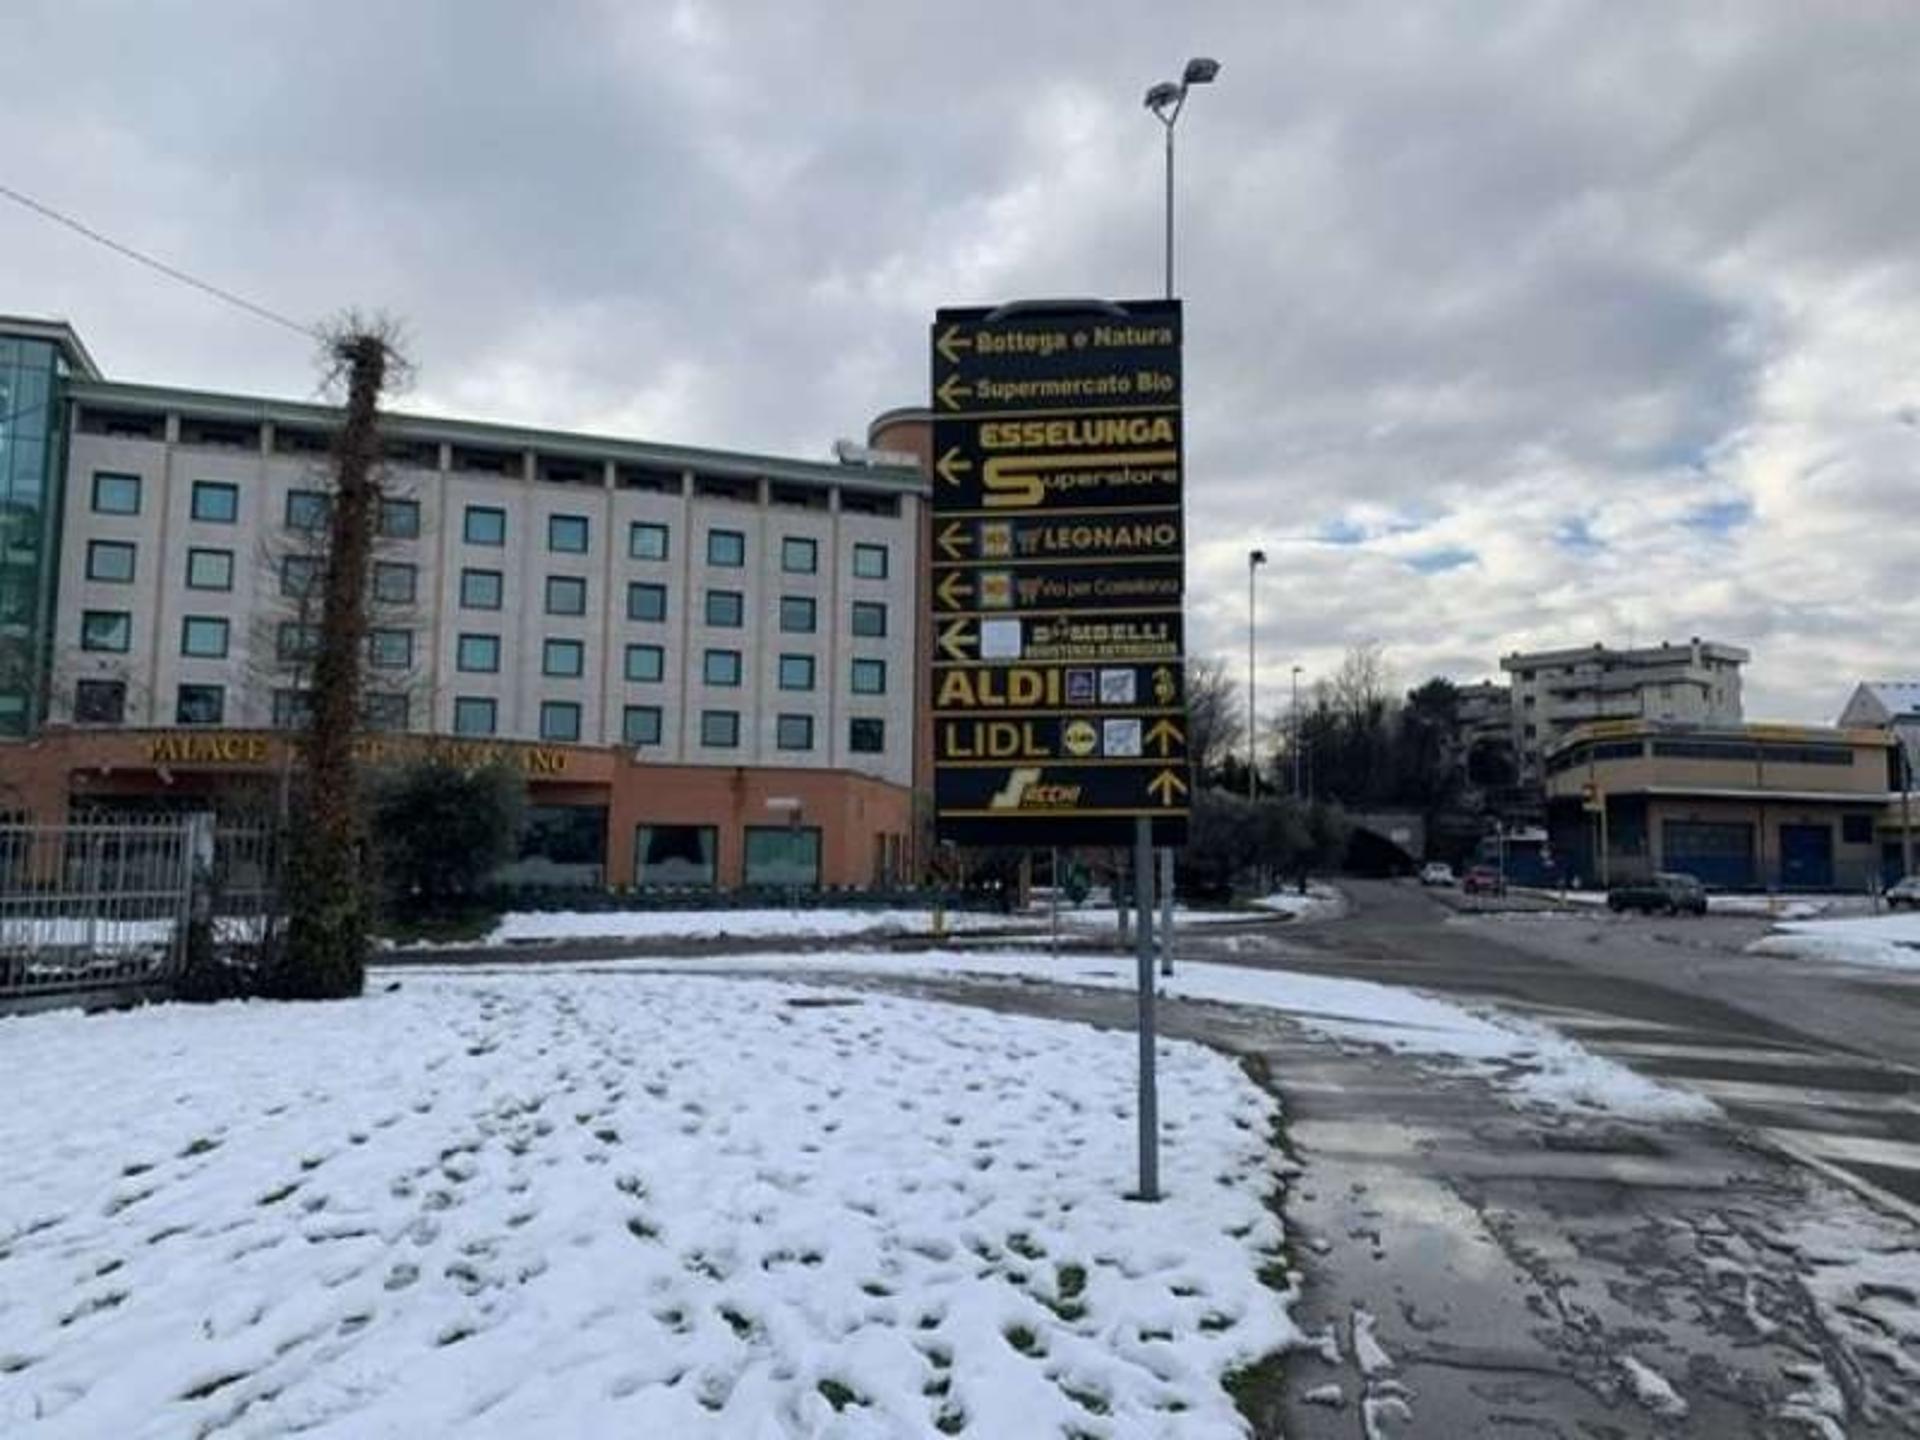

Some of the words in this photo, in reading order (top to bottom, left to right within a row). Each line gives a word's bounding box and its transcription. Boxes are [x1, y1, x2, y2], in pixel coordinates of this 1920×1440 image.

[1093, 325, 1173, 347] Natura
[976, 375, 1131, 400] Supermercato
[1136, 371, 1174, 393] Bio
[979, 417, 1176, 449] ESSELUNGA
[1043, 524, 1176, 549] LEGNANO
[938, 668, 1060, 707] ALDI
[946, 720, 1050, 757] LIDL
